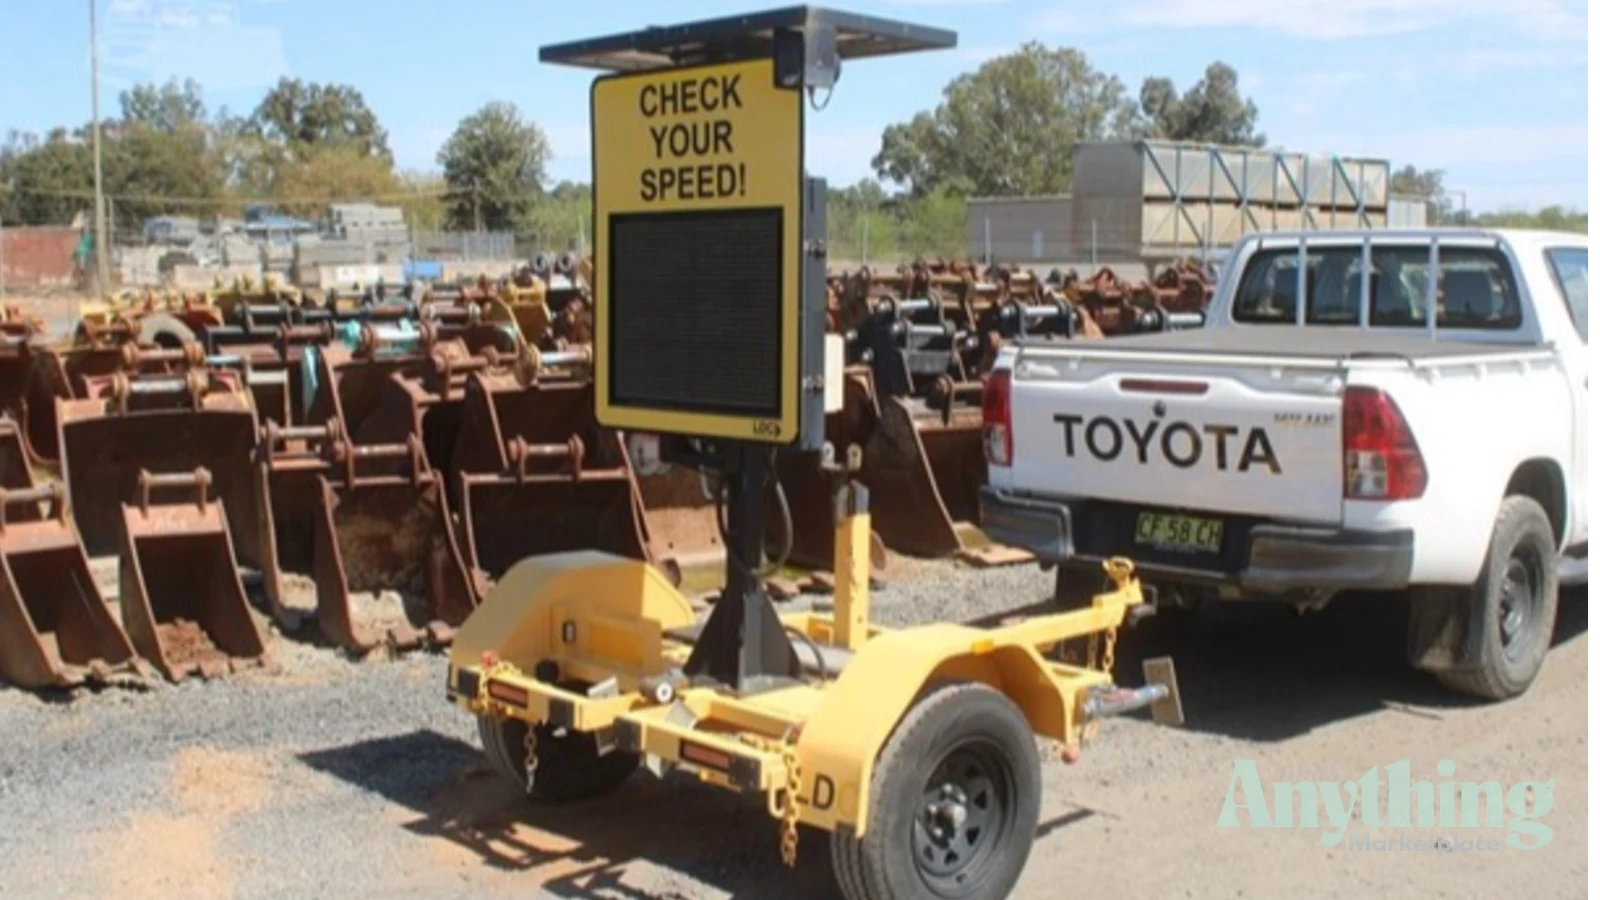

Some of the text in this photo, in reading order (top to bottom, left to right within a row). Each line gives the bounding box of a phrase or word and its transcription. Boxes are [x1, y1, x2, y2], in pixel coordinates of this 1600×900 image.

[639, 74, 742, 118] CHECK
[649, 119, 733, 159] YOUR
[640, 162, 747, 202] SPEED!
[1053, 414, 1282, 474] TOYOTA
